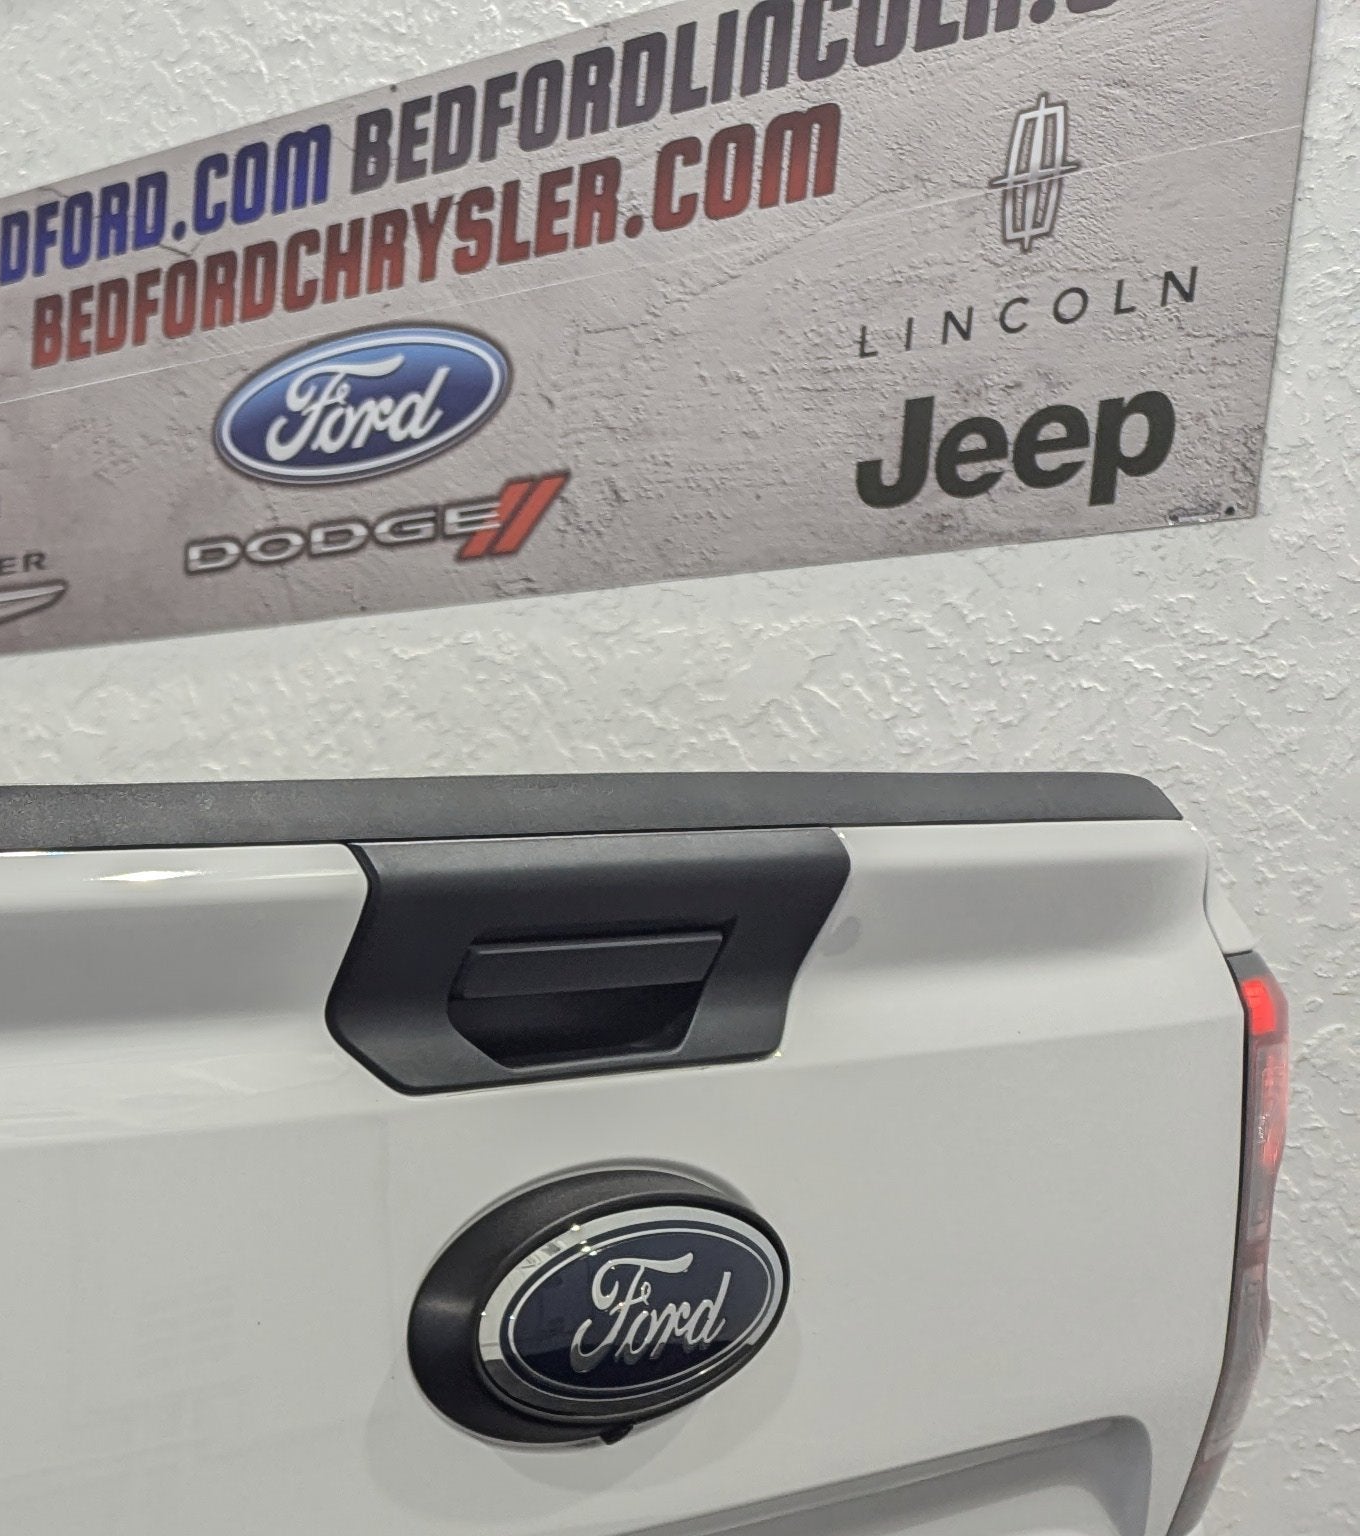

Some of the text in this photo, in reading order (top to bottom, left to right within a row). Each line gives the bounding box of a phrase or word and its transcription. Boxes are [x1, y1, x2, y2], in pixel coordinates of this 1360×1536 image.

[30, 102, 842, 370] BEDFORDCHRYSLER.COM
[858, 266, 1199, 359] LINCOLN
[265, 353, 452, 462] Ford
[855, 390, 1176, 509] Jeep
[185, 496, 503, 577] DODGE
[570, 1251, 732, 1374] Ford
